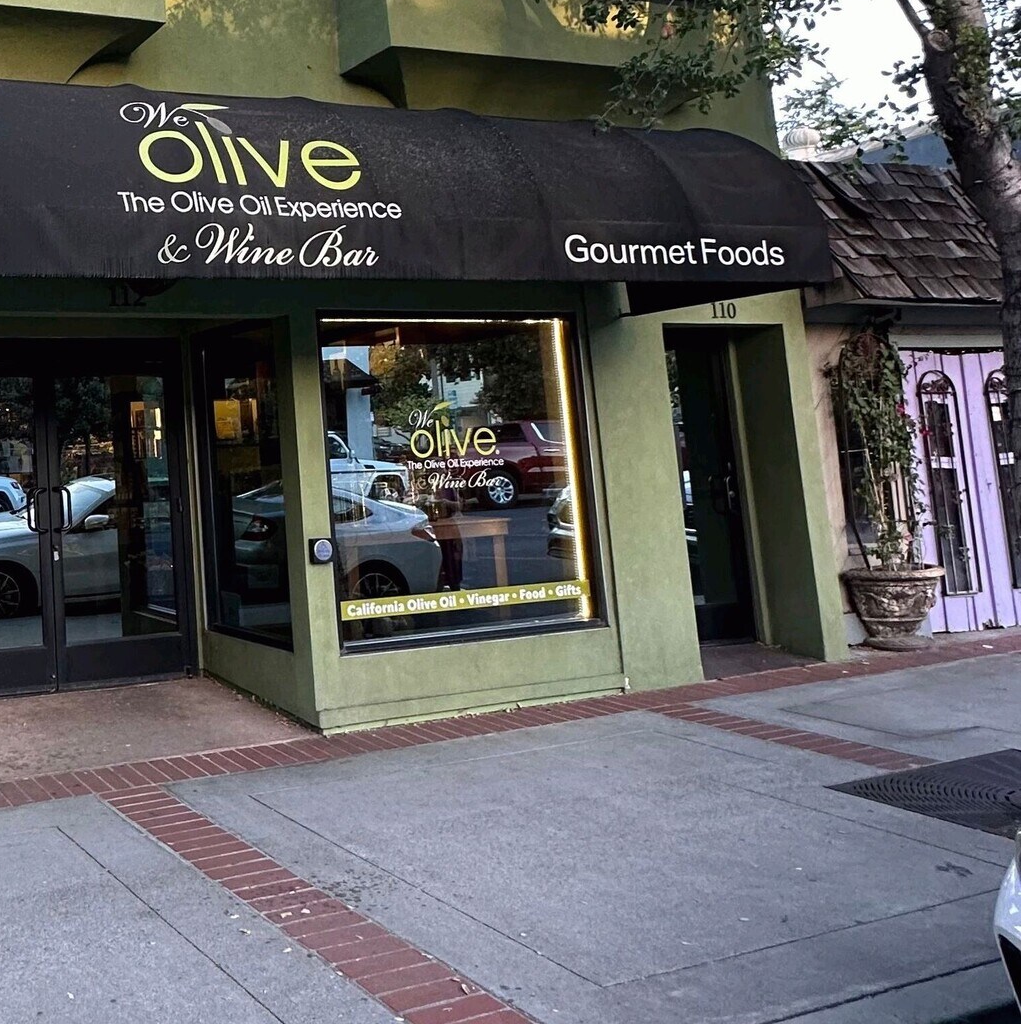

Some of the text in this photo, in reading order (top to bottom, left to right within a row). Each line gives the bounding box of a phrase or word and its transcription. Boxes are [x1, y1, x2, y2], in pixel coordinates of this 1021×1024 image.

[119, 101, 189, 129] We
[116, 190, 403, 222] The Olive Oil Experience
[156, 222, 380, 268] & Wine Bar
[563, 233, 786, 266] Gourmet Foods
[710, 301, 737, 320] 110
[407, 460, 423, 470] The
[427, 470, 467, 492] Wine
[467, 468, 502, 489] Bar
[346, 584, 582, 618] California Olive Oil Vinegar Food Gifts
